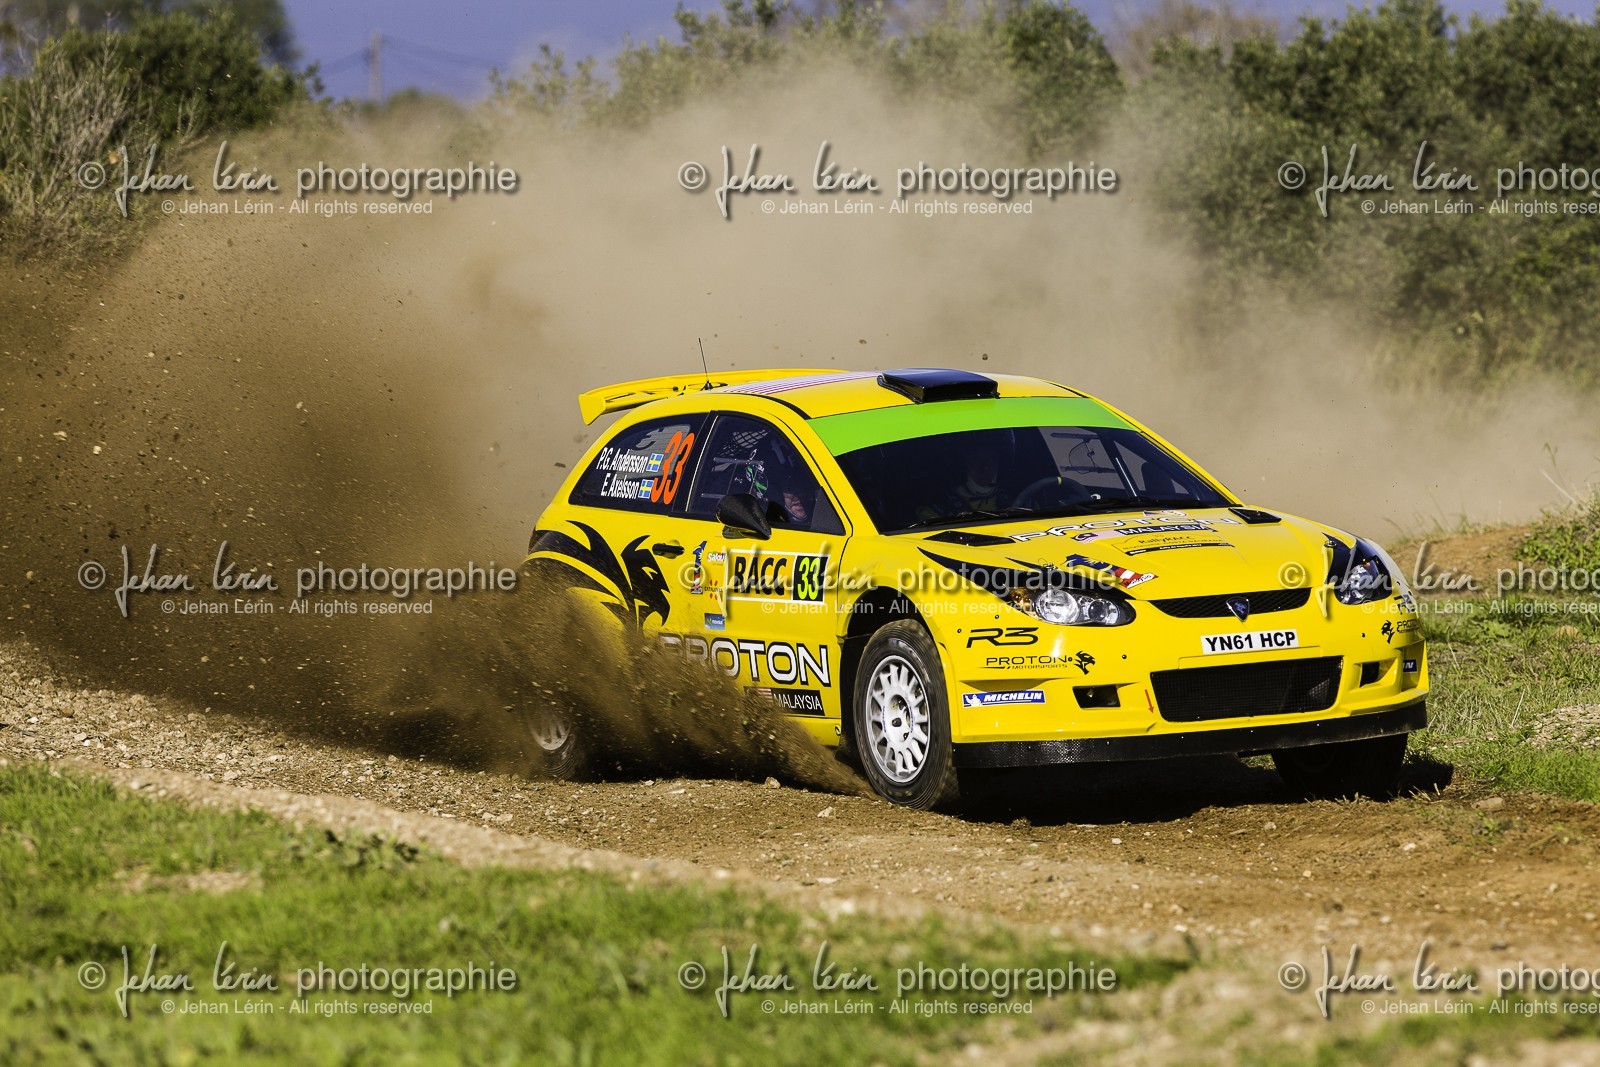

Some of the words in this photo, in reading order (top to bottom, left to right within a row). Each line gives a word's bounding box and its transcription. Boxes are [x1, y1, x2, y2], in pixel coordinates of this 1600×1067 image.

[596, 447, 613, 470] P.G.
[611, 448, 648, 474] Andersson
[651, 431, 695, 505] 33
[600, 473, 611, 496] E.
[608, 473, 640, 500] Axelsson
[1009, 516, 1241, 542] PROTON
[1119, 524, 1210, 535] MALAYSIA
[733, 556, 788, 596] RACC
[798, 557, 820, 600] 33
[966, 627, 1039, 648] R3
[1205, 634, 1253, 651] YN61
[1260, 632, 1296, 648] HCP
[986, 655, 1067, 666] PROTON
[773, 693, 823, 711] MALAYSIA
[984, 692, 1042, 702] MICHELIN
